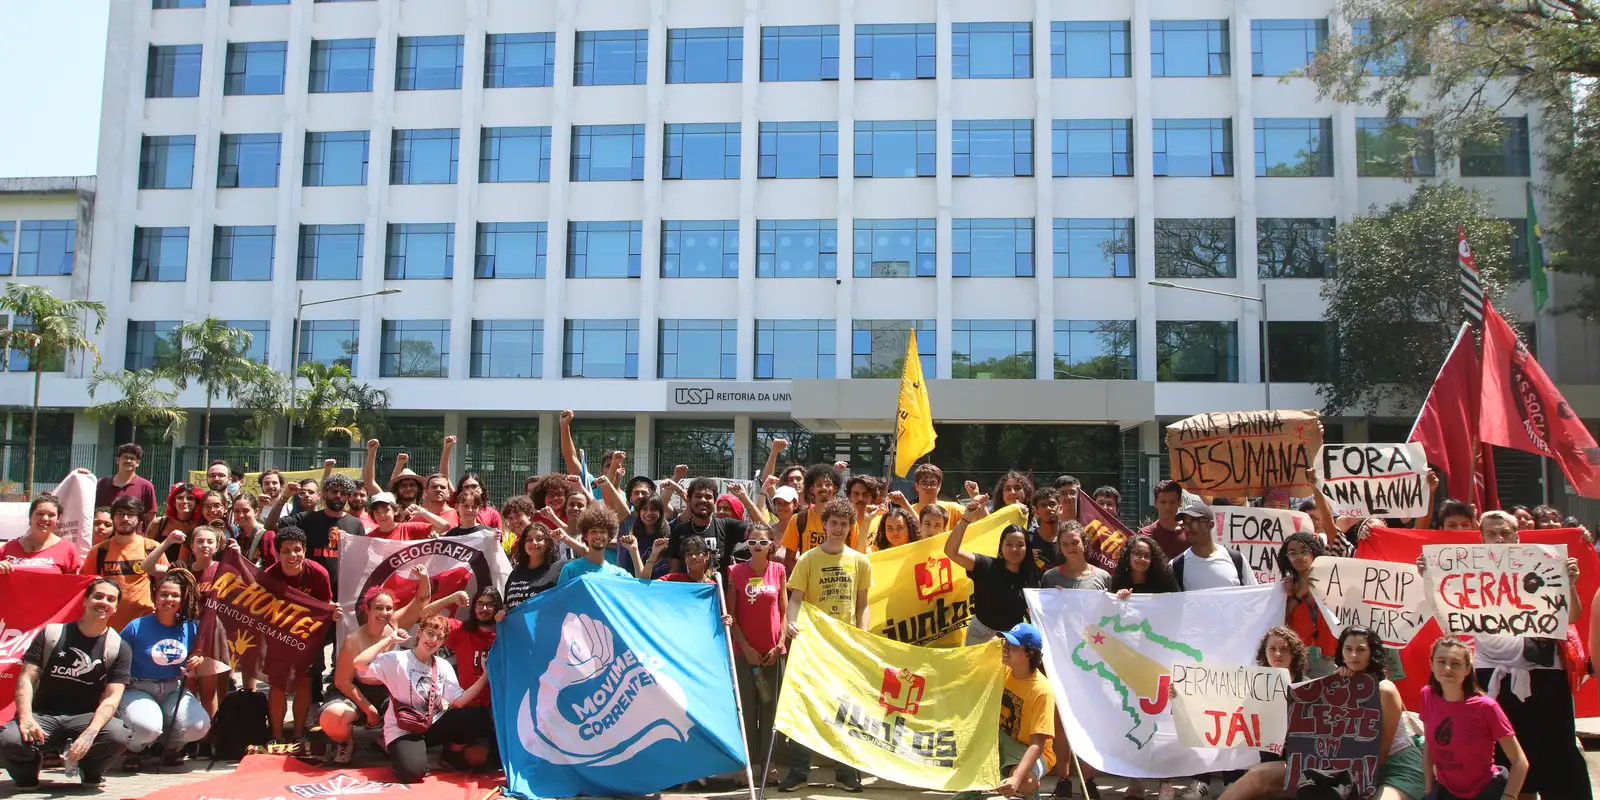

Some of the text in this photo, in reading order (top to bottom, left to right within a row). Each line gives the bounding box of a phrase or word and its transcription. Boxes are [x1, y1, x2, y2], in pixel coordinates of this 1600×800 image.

[675, 388, 714, 405] USP
[716, 392, 755, 401] REITORIA
[757, 393, 771, 401] DA
[1179, 409, 1285, 441] ANA LANNA
[1174, 439, 1312, 489] DESUMANA
[1322, 445, 1412, 480] FORA
[1322, 473, 1424, 515] ANA LANNA
[1229, 512, 1284, 542] FORA
[389, 541, 475, 570] GEOGRAFIA
[1437, 546, 1524, 571] GREVE
[1253, 572, 1277, 585] ACH
[1326, 563, 1415, 602] A PRIP
[1439, 570, 1537, 610] GERAL
[204, 597, 307, 652] JUVENTUDE SEM MEDO
[210, 571, 324, 640] AFRONTE!
[1447, 609, 1559, 637] EDUCAÇÃO
[1172, 664, 1289, 703] PERMANÊNCIA
[1202, 705, 1262, 748] JÁ!
[1287, 702, 1381, 742] LESTE
